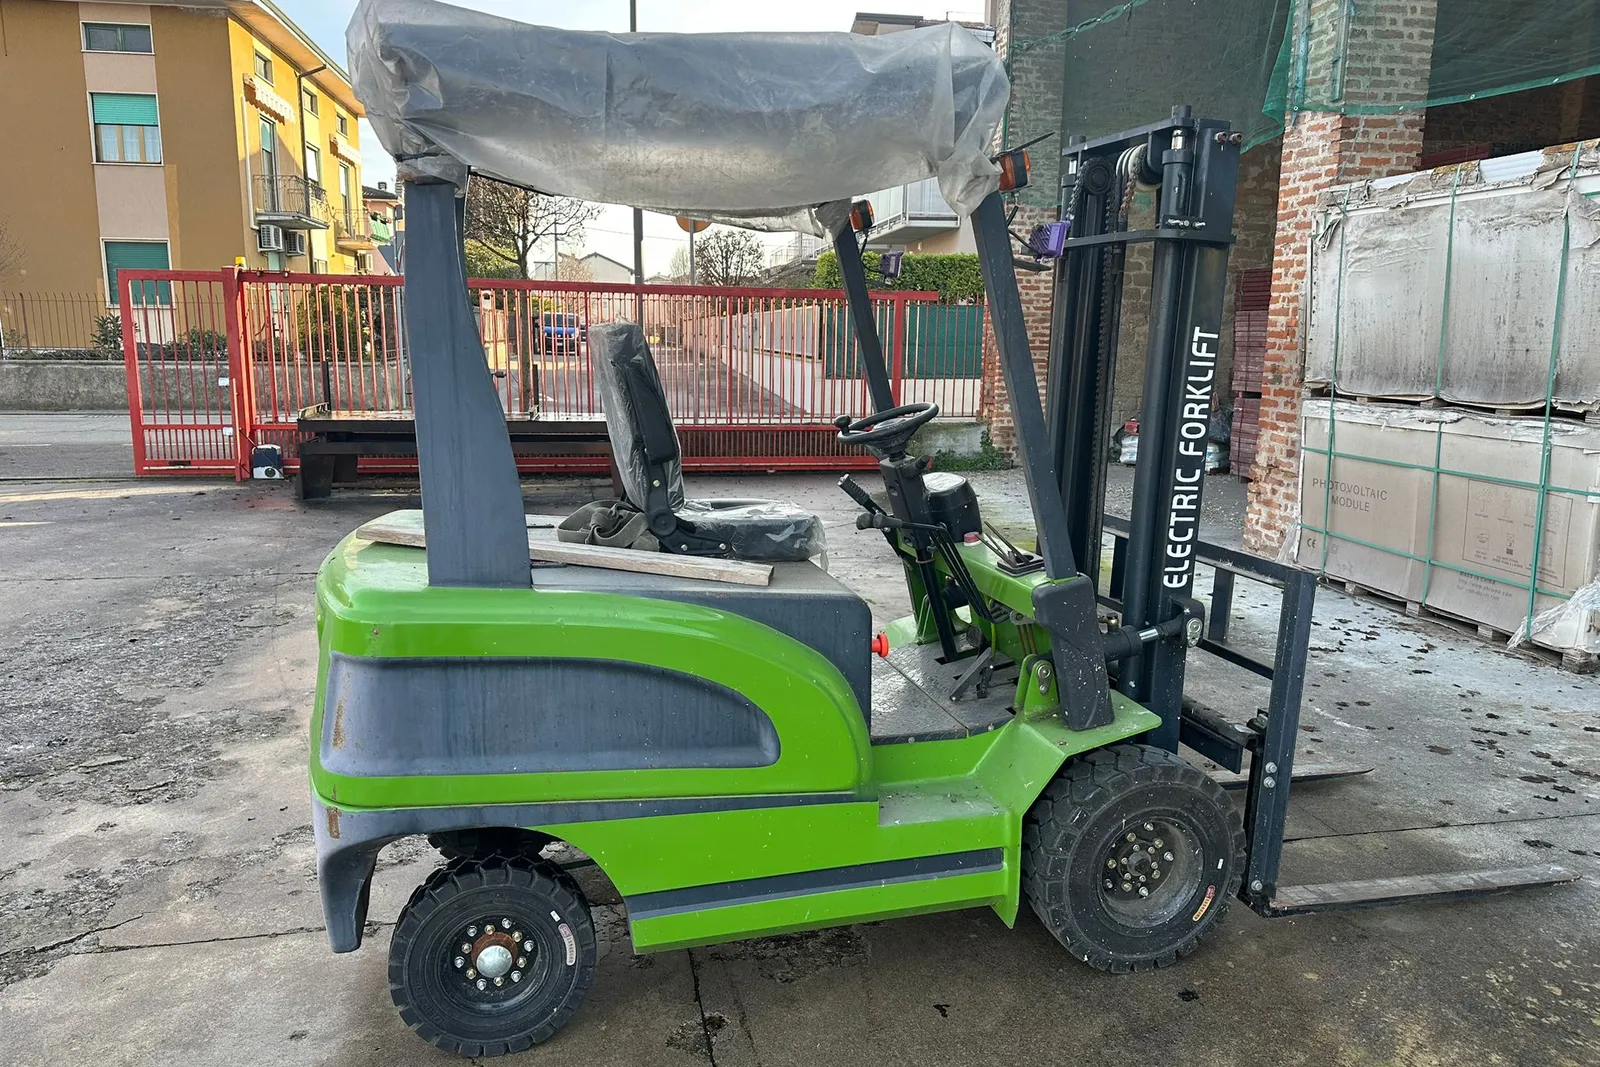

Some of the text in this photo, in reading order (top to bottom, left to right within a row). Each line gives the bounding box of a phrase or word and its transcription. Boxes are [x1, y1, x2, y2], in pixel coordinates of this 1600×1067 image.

[1163, 326, 1219, 588] ELECTRIC FORKLIFT
[1312, 478, 1388, 501] PHOTOVOLTAIC
[1331, 495, 1370, 512] MODULE
[1307, 538, 1317, 549] CE
